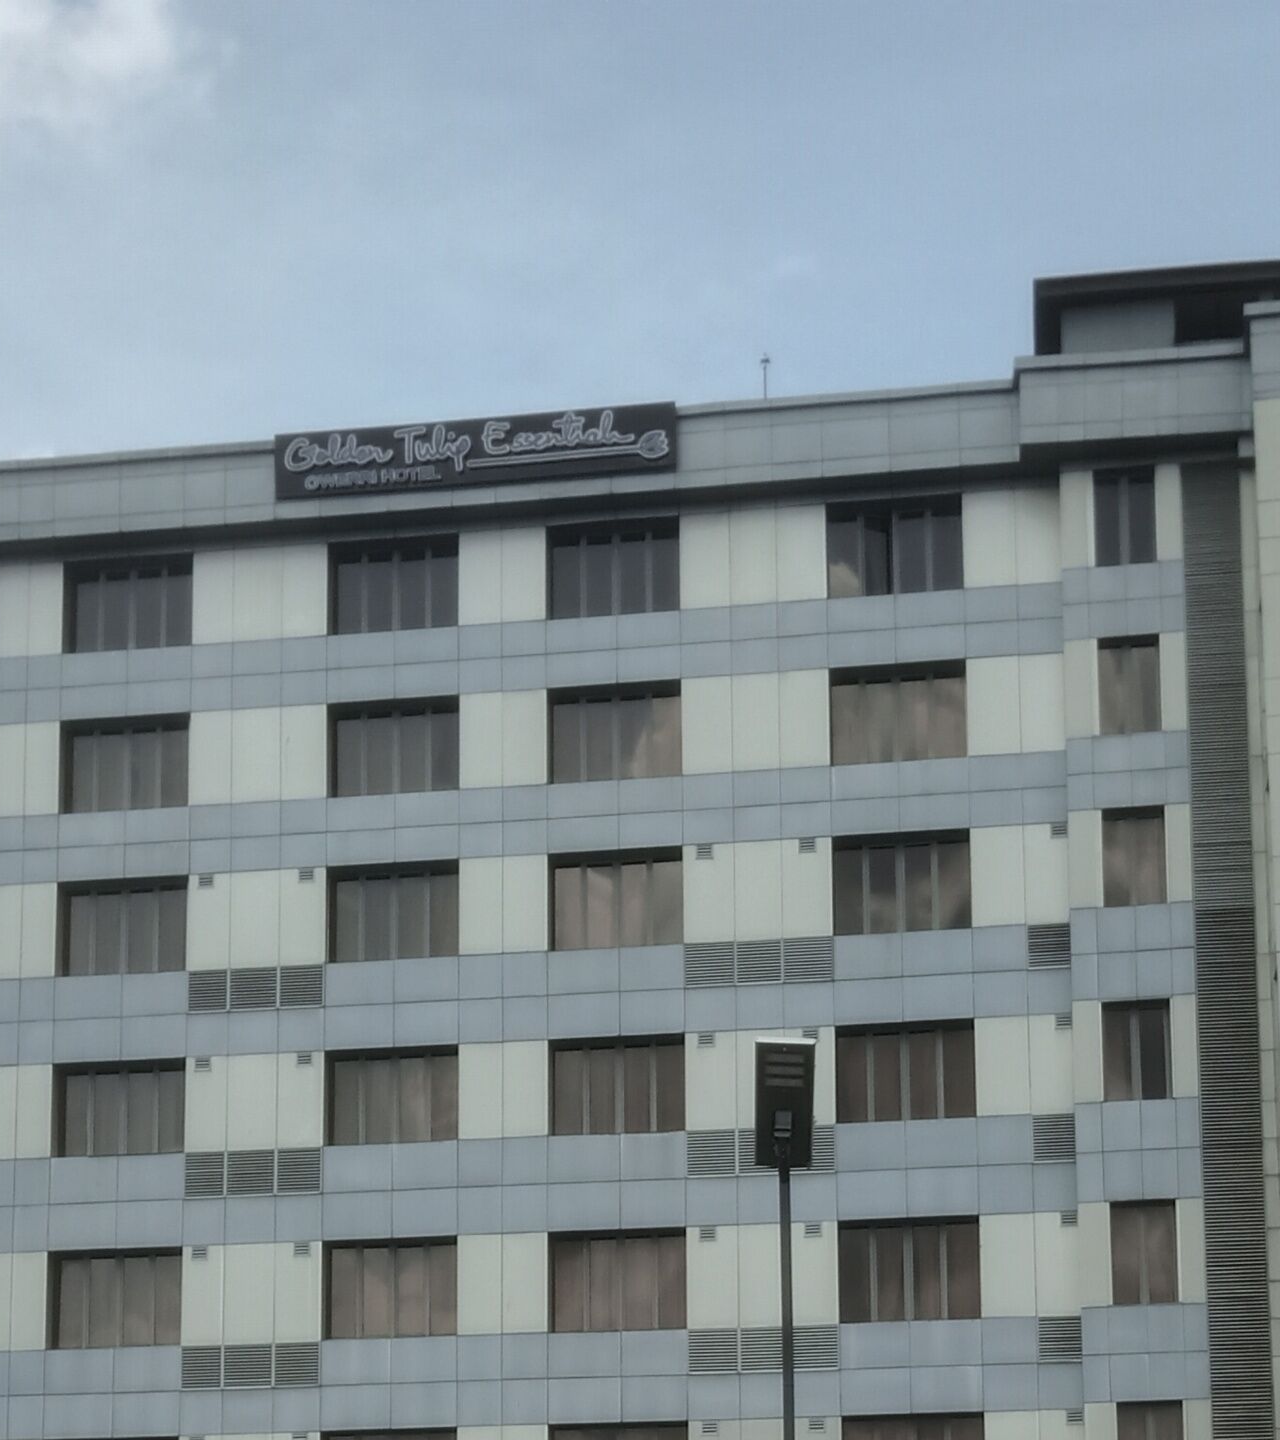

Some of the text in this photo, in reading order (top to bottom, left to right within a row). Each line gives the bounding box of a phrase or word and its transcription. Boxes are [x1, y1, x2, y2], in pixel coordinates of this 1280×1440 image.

[284, 433, 393, 472] Golden
[393, 424, 472, 473] Tulip
[304, 465, 442, 491] OWERRI HOTEL
